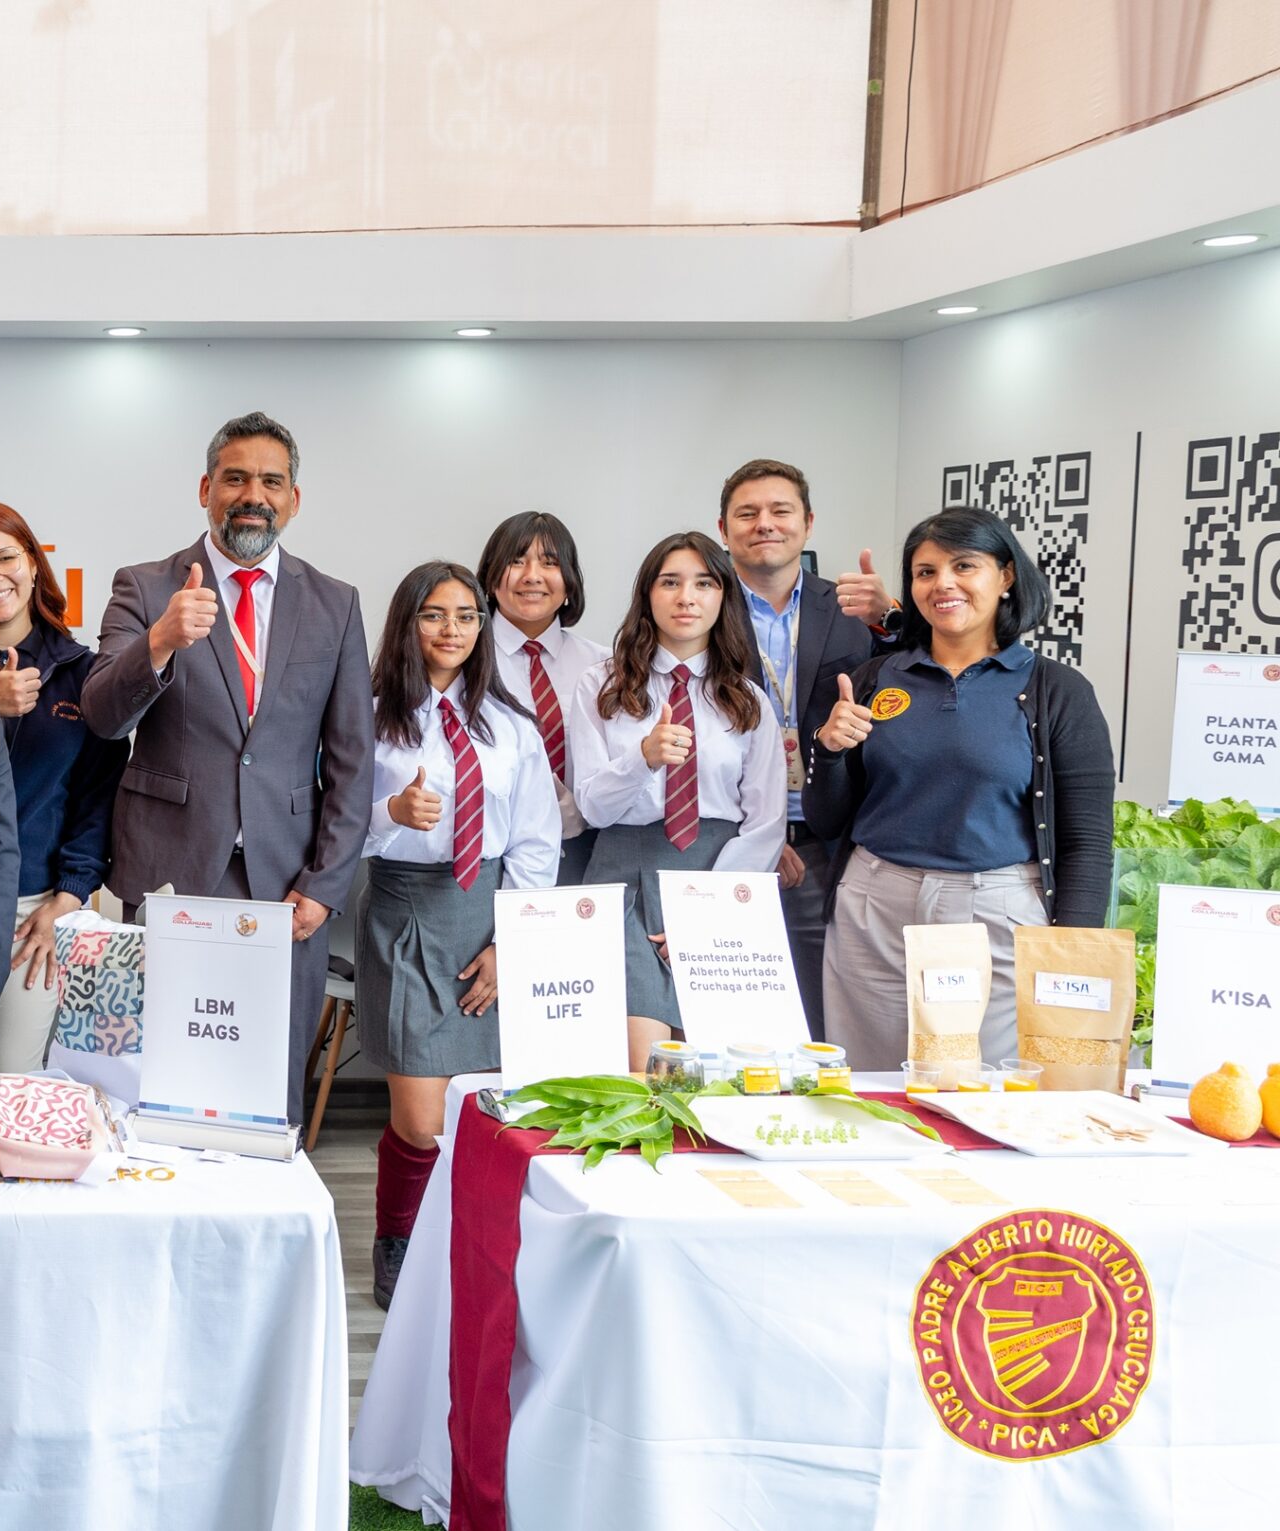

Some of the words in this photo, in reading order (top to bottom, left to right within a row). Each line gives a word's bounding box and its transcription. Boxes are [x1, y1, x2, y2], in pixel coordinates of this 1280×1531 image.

[1206, 715, 1278, 731] PLANTA
[1204, 733, 1277, 748] CUARTA
[1213, 751, 1265, 765] GAMA
[713, 938, 743, 949] Liceo
[679, 952, 750, 963] Bicentenario
[752, 952, 784, 963] Padre
[689, 966, 730, 977] Alberto
[732, 966, 778, 977] Hurtado
[532, 979, 594, 997] MANGO
[690, 980, 743, 993] Cruchaga
[745, 980, 758, 991] de
[761, 980, 786, 991] Pica
[1053, 980, 1090, 994] K'ISA
[194, 998, 235, 1016] LBM
[1211, 989, 1272, 1009] K'ISA
[546, 1003, 582, 1020] LIFE
[188, 1022, 240, 1041] BAGS
[947, 1219, 1053, 1281] ALBERTO
[1059, 1222, 1144, 1303] HURTADO
[1017, 1284, 1057, 1293] PICA
[920, 1278, 954, 1364] PADRE
[1080, 1309, 1149, 1436] CRUCHAGA
[928, 1370, 973, 1432] LICEO
[990, 1424, 1057, 1449] PICA
